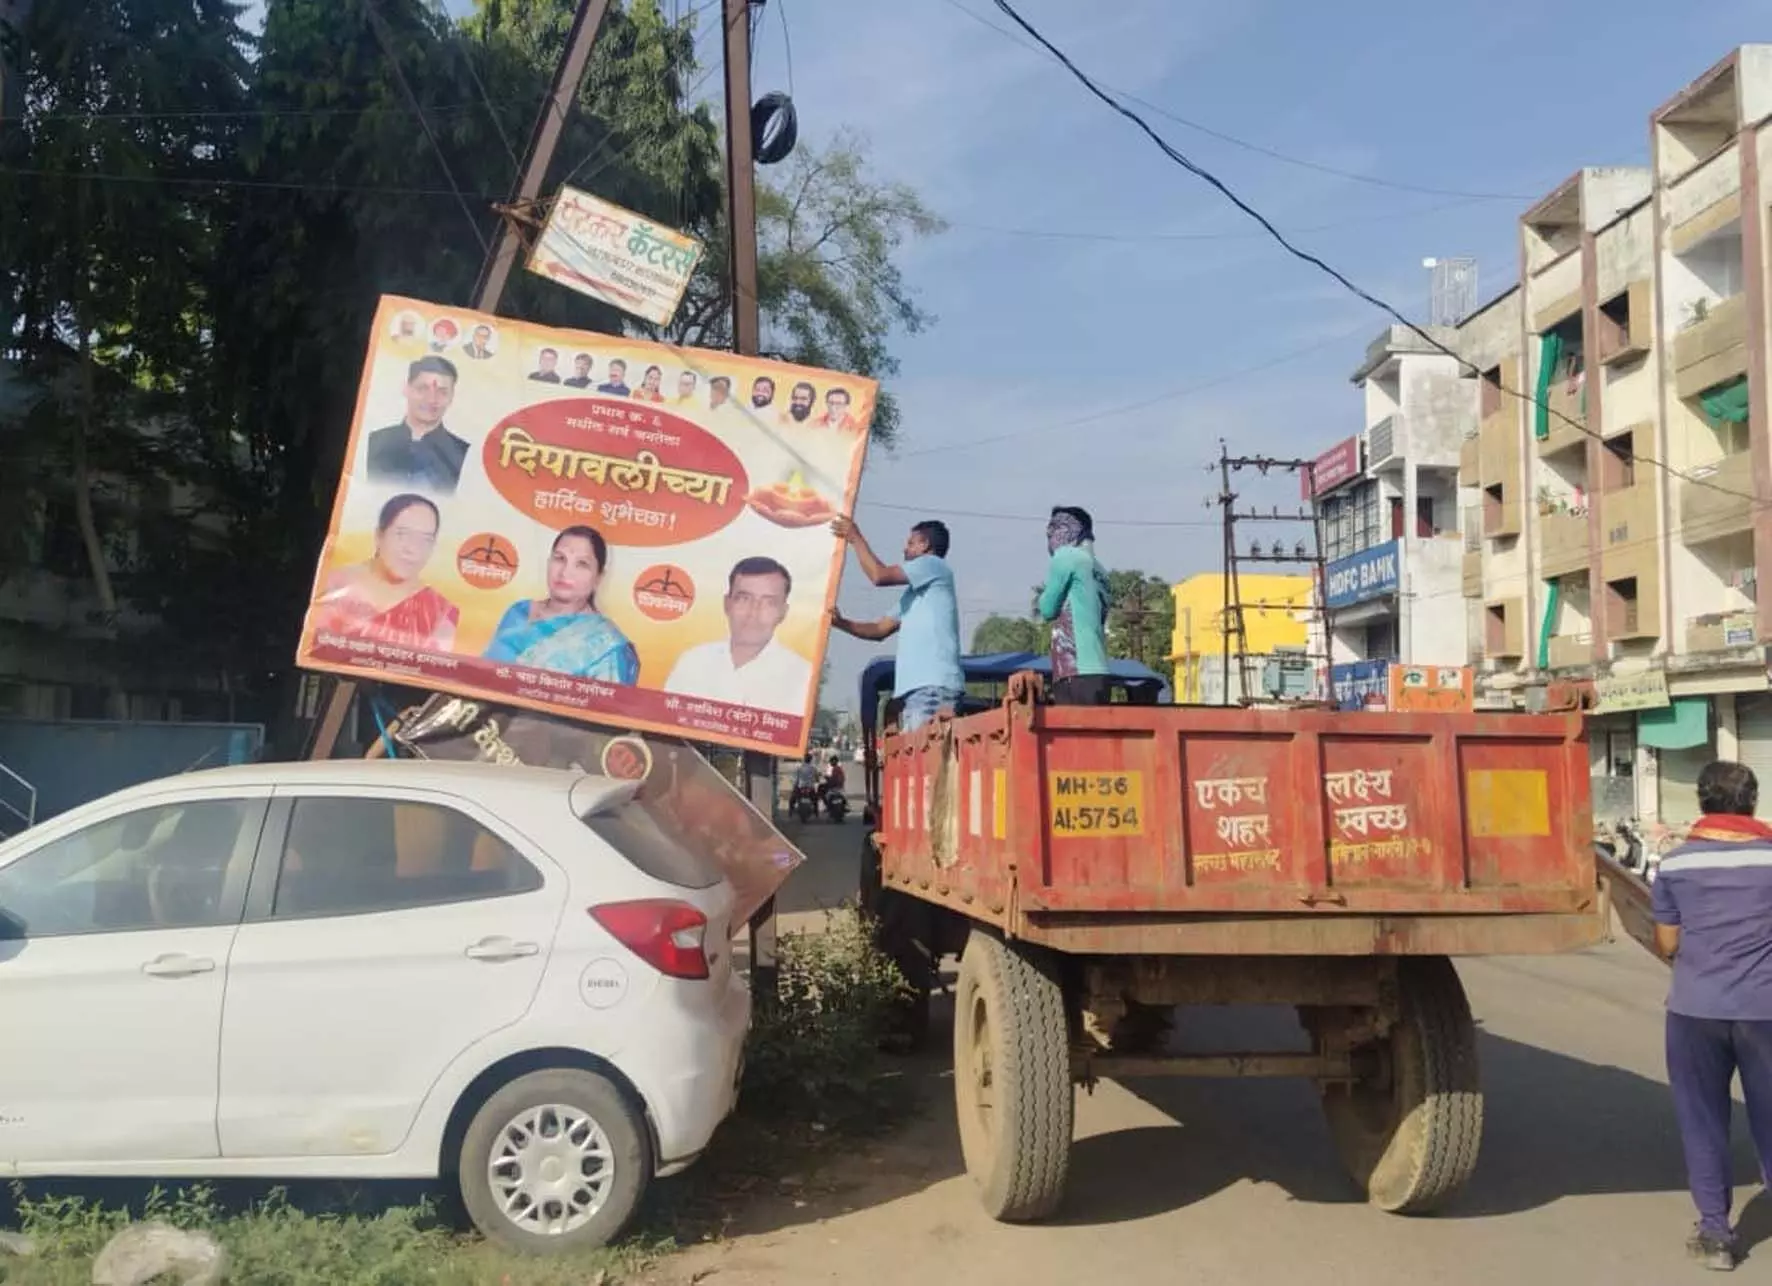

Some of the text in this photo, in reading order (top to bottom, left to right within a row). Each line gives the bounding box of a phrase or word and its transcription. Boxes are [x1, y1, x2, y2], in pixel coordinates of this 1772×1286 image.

[499, 427, 734, 505] दिपावलीच्या
[533, 487, 677, 531] हार्दिक शुभेच्छा!
[1329, 567, 1358, 598] HDFC
[1360, 553, 1396, 588] BANK
[1193, 768, 1393, 810] एकच लक्ष्य
[1216, 803, 1408, 848] शहर स्वच्छ
